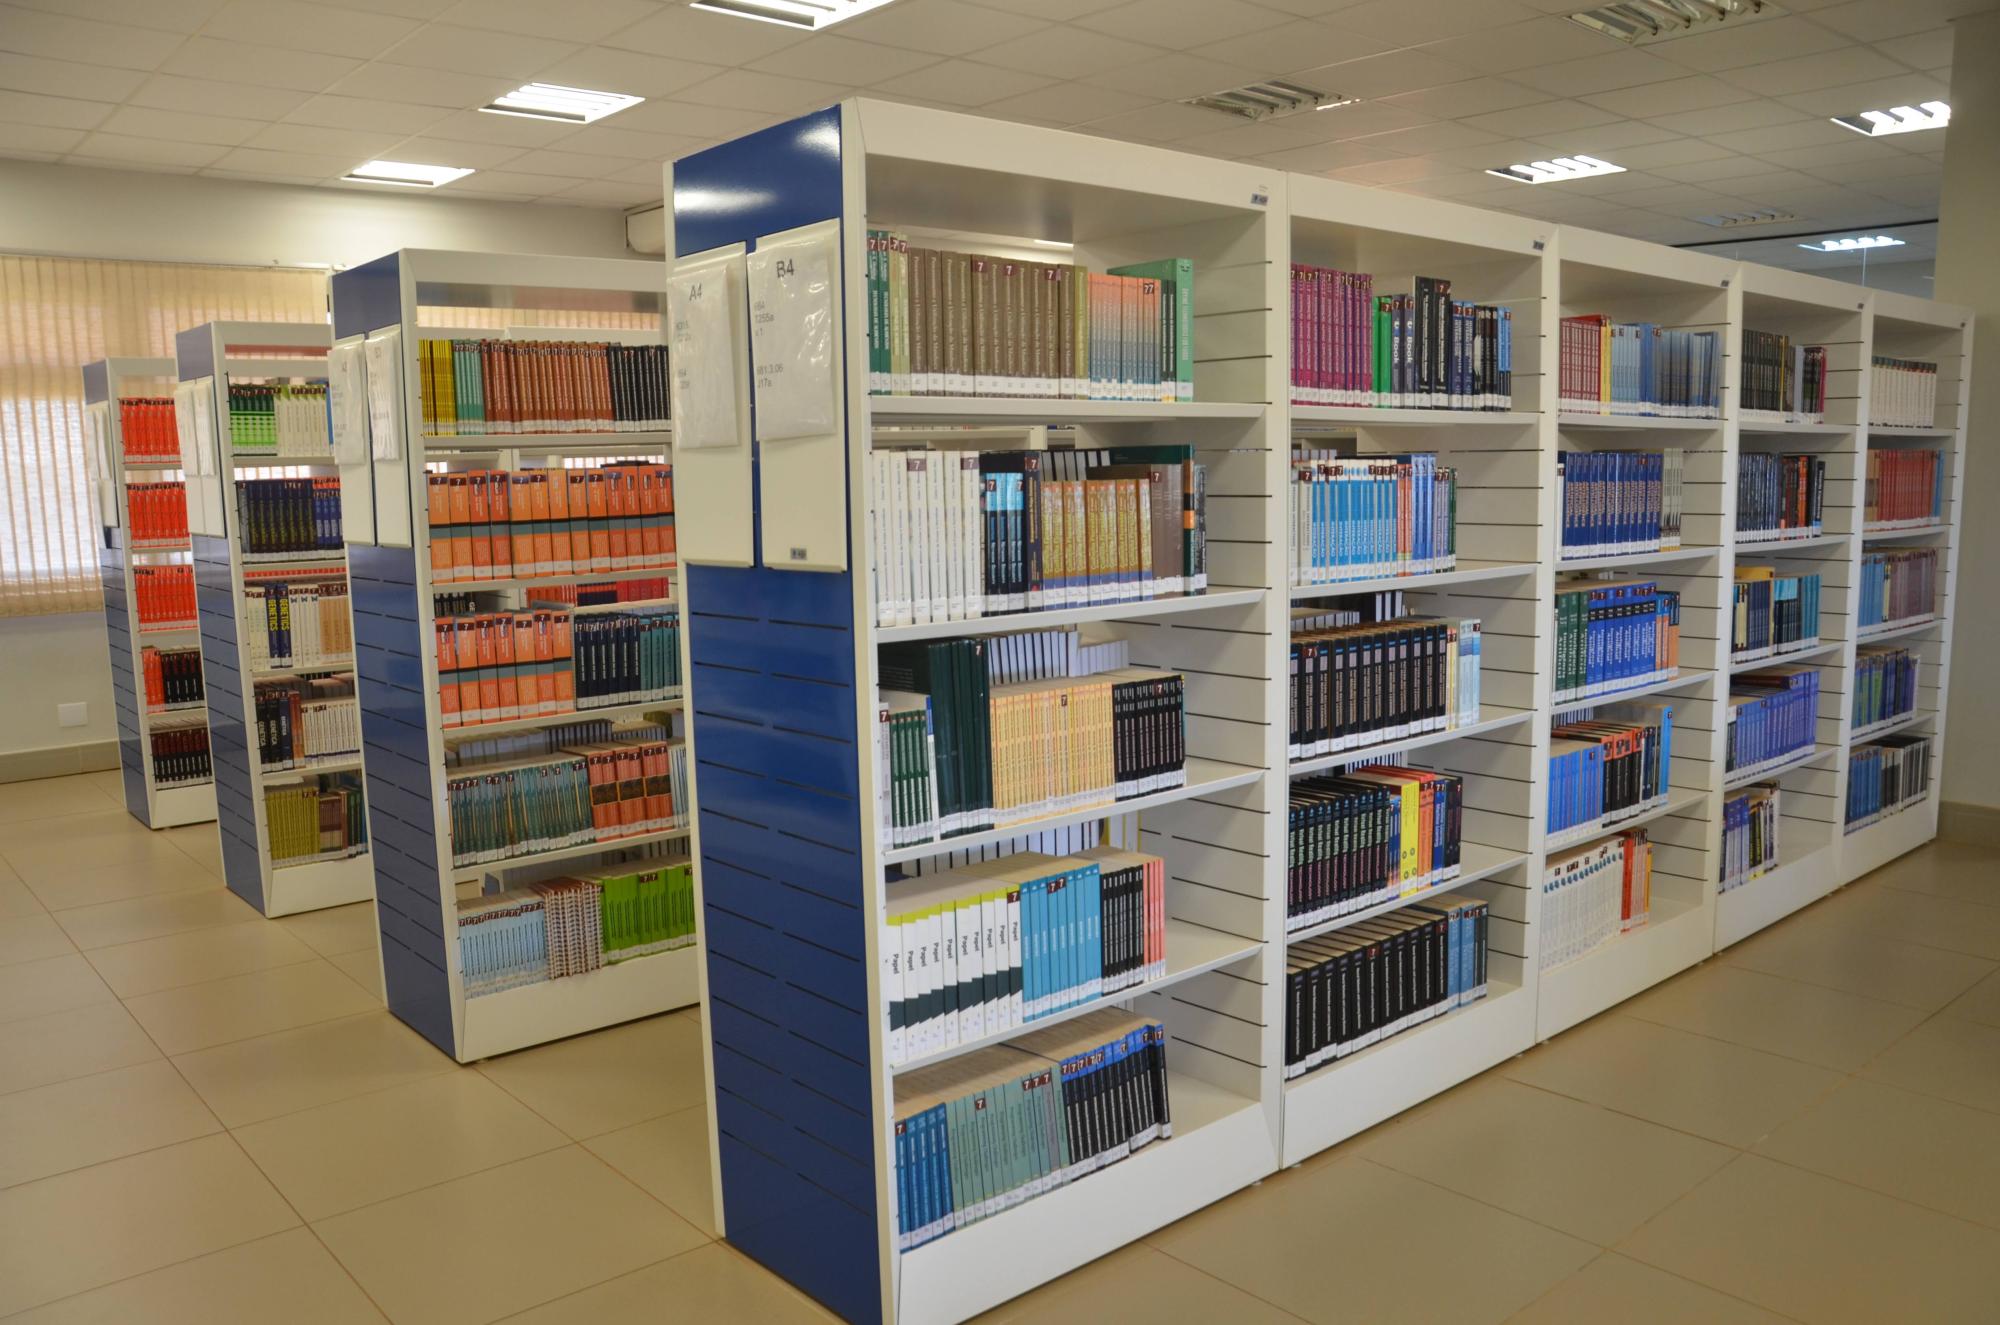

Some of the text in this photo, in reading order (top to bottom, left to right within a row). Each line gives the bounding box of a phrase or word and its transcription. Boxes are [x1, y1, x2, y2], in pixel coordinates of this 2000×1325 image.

[870, 240, 875, 249] 7
[882, 240, 886, 250] 7
[893, 239, 898, 248] 7
[901, 243, 906, 251] 7
[776, 259, 794, 278] B4
[978, 262, 983, 271] 7
[1007, 266, 1012, 274] 7
[1048, 270, 1053, 279] 7
[689, 282, 702, 301] A4
[1145, 284, 1149, 293] 7
[1149, 284, 1153, 293] 7
[914, 461, 920, 470] 7
[969, 460, 974, 468] 7
[1032, 460, 1036, 468] 7
[1155, 473, 1159, 481] 7
[989, 481, 994, 490] 7
[1018, 481, 1022, 490] 7
[268, 600, 278, 631] GENETICS
[280, 598, 289, 631] GENETICS
[976, 646, 980, 655] 7
[882, 712, 887, 721] 7
[1051, 883, 1055, 891] 7
[1060, 879, 1064, 887] 7
[1090, 1055, 1095, 1063] 7
[1098, 1053, 1103, 1061] 7
[1072, 1064, 1076, 1072] 7
[1079, 1060, 1084, 1068] 7
[1063, 1065, 1068, 1073] 7
[1034, 1078, 1039, 1086] 7
[1044, 1074, 1048, 1082] 7
[1024, 1081, 1029, 1089] 7
[978, 1100, 983, 1108] 7
[898, 1124, 902, 1134] 7
